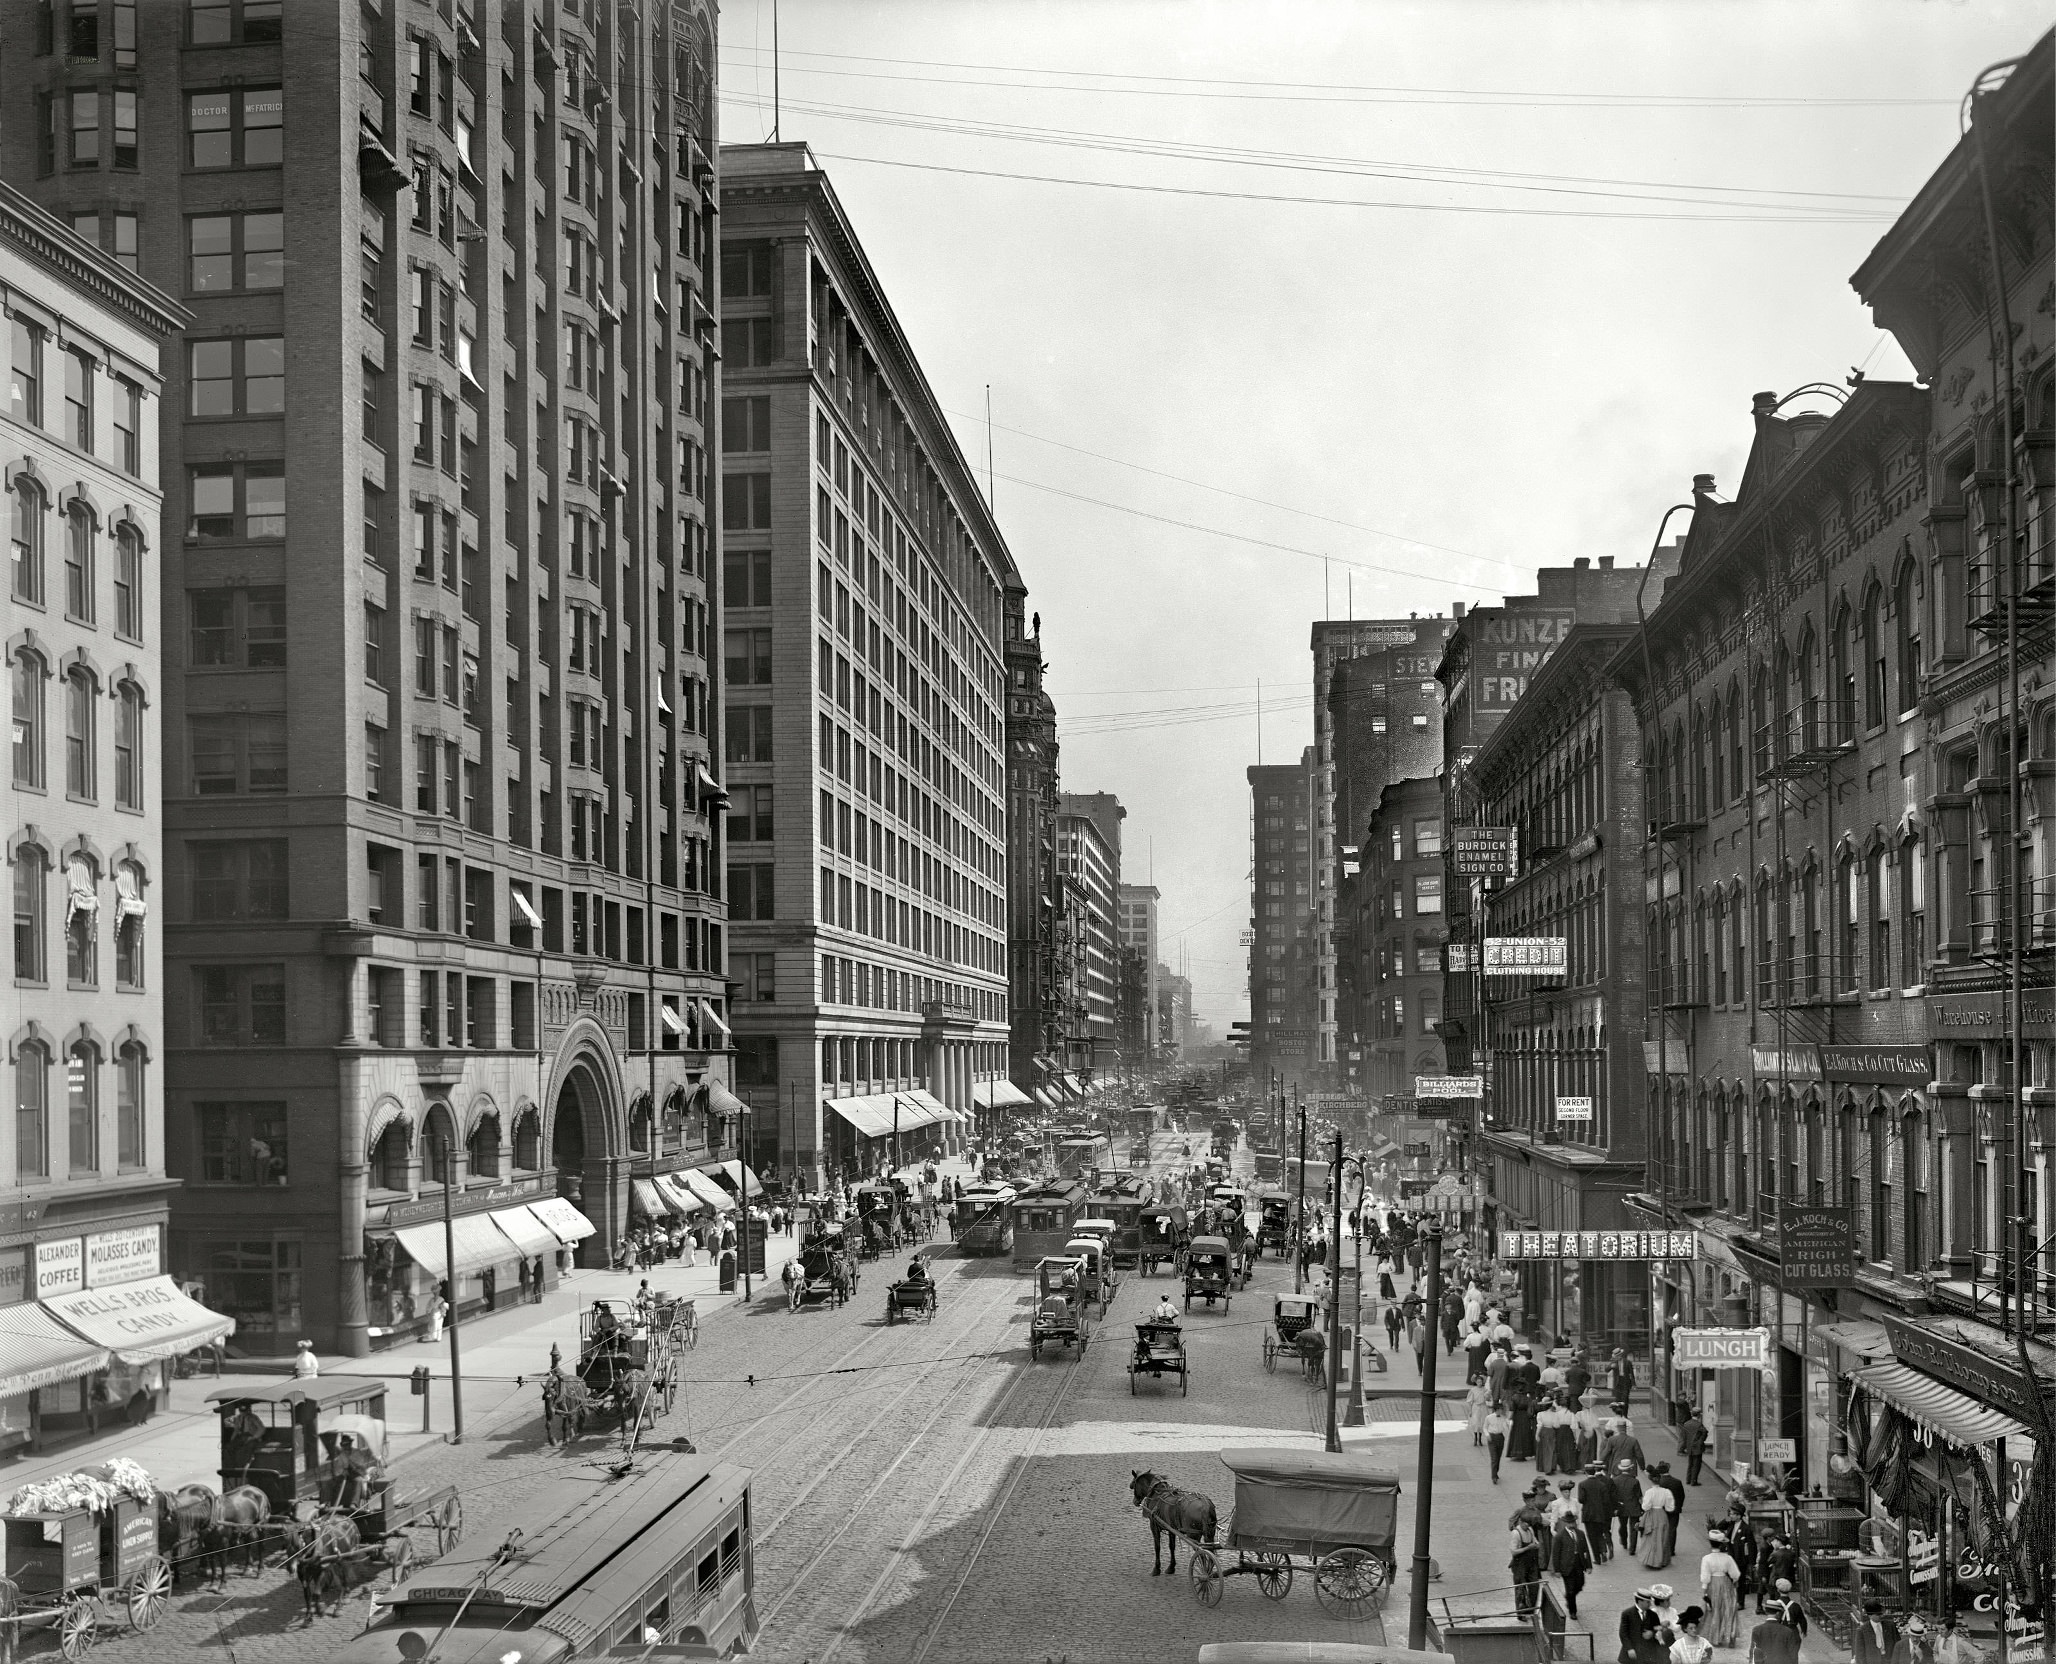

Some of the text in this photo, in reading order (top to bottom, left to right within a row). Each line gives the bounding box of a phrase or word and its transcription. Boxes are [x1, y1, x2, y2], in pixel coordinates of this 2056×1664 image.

[192, 107, 228, 116] DOCTOR
[1471, 830, 1493, 840] THE
[1457, 841, 1506, 851] BURDICK
[1459, 852, 1505, 861] ENAMEL
[1460, 863, 1504, 872] SIGN CO
[1488, 948, 1563, 965] CREDIT
[1486, 967, 1565, 975] CLOTHING HOUSE
[1934, 1005, 1992, 1025] Warehouse
[2022, 1001, 2055, 1023] ffice
[1558, 1098, 1590, 1106] FOR RENT
[1803, 1214, 1827, 1225] KOCH
[91, 1237, 158, 1264] MOLASSES CANDY.
[1504, 1234, 1692, 1258] THEATORIUM
[39, 1243, 79, 1264] ALEXANDER
[39, 1267, 79, 1287] COFFEE
[1785, 1263, 1806, 1278] CUT
[64, 1287, 174, 1318] WELLS BROS.
[1894, 1330, 1926, 1360] John
[1940, 1349, 2025, 1406] Thompson
[1764, 1441, 1789, 1451] LUNCH
[1763, 1451, 1791, 1459] READY
[124, 1517, 153, 1535] AMERICAN
